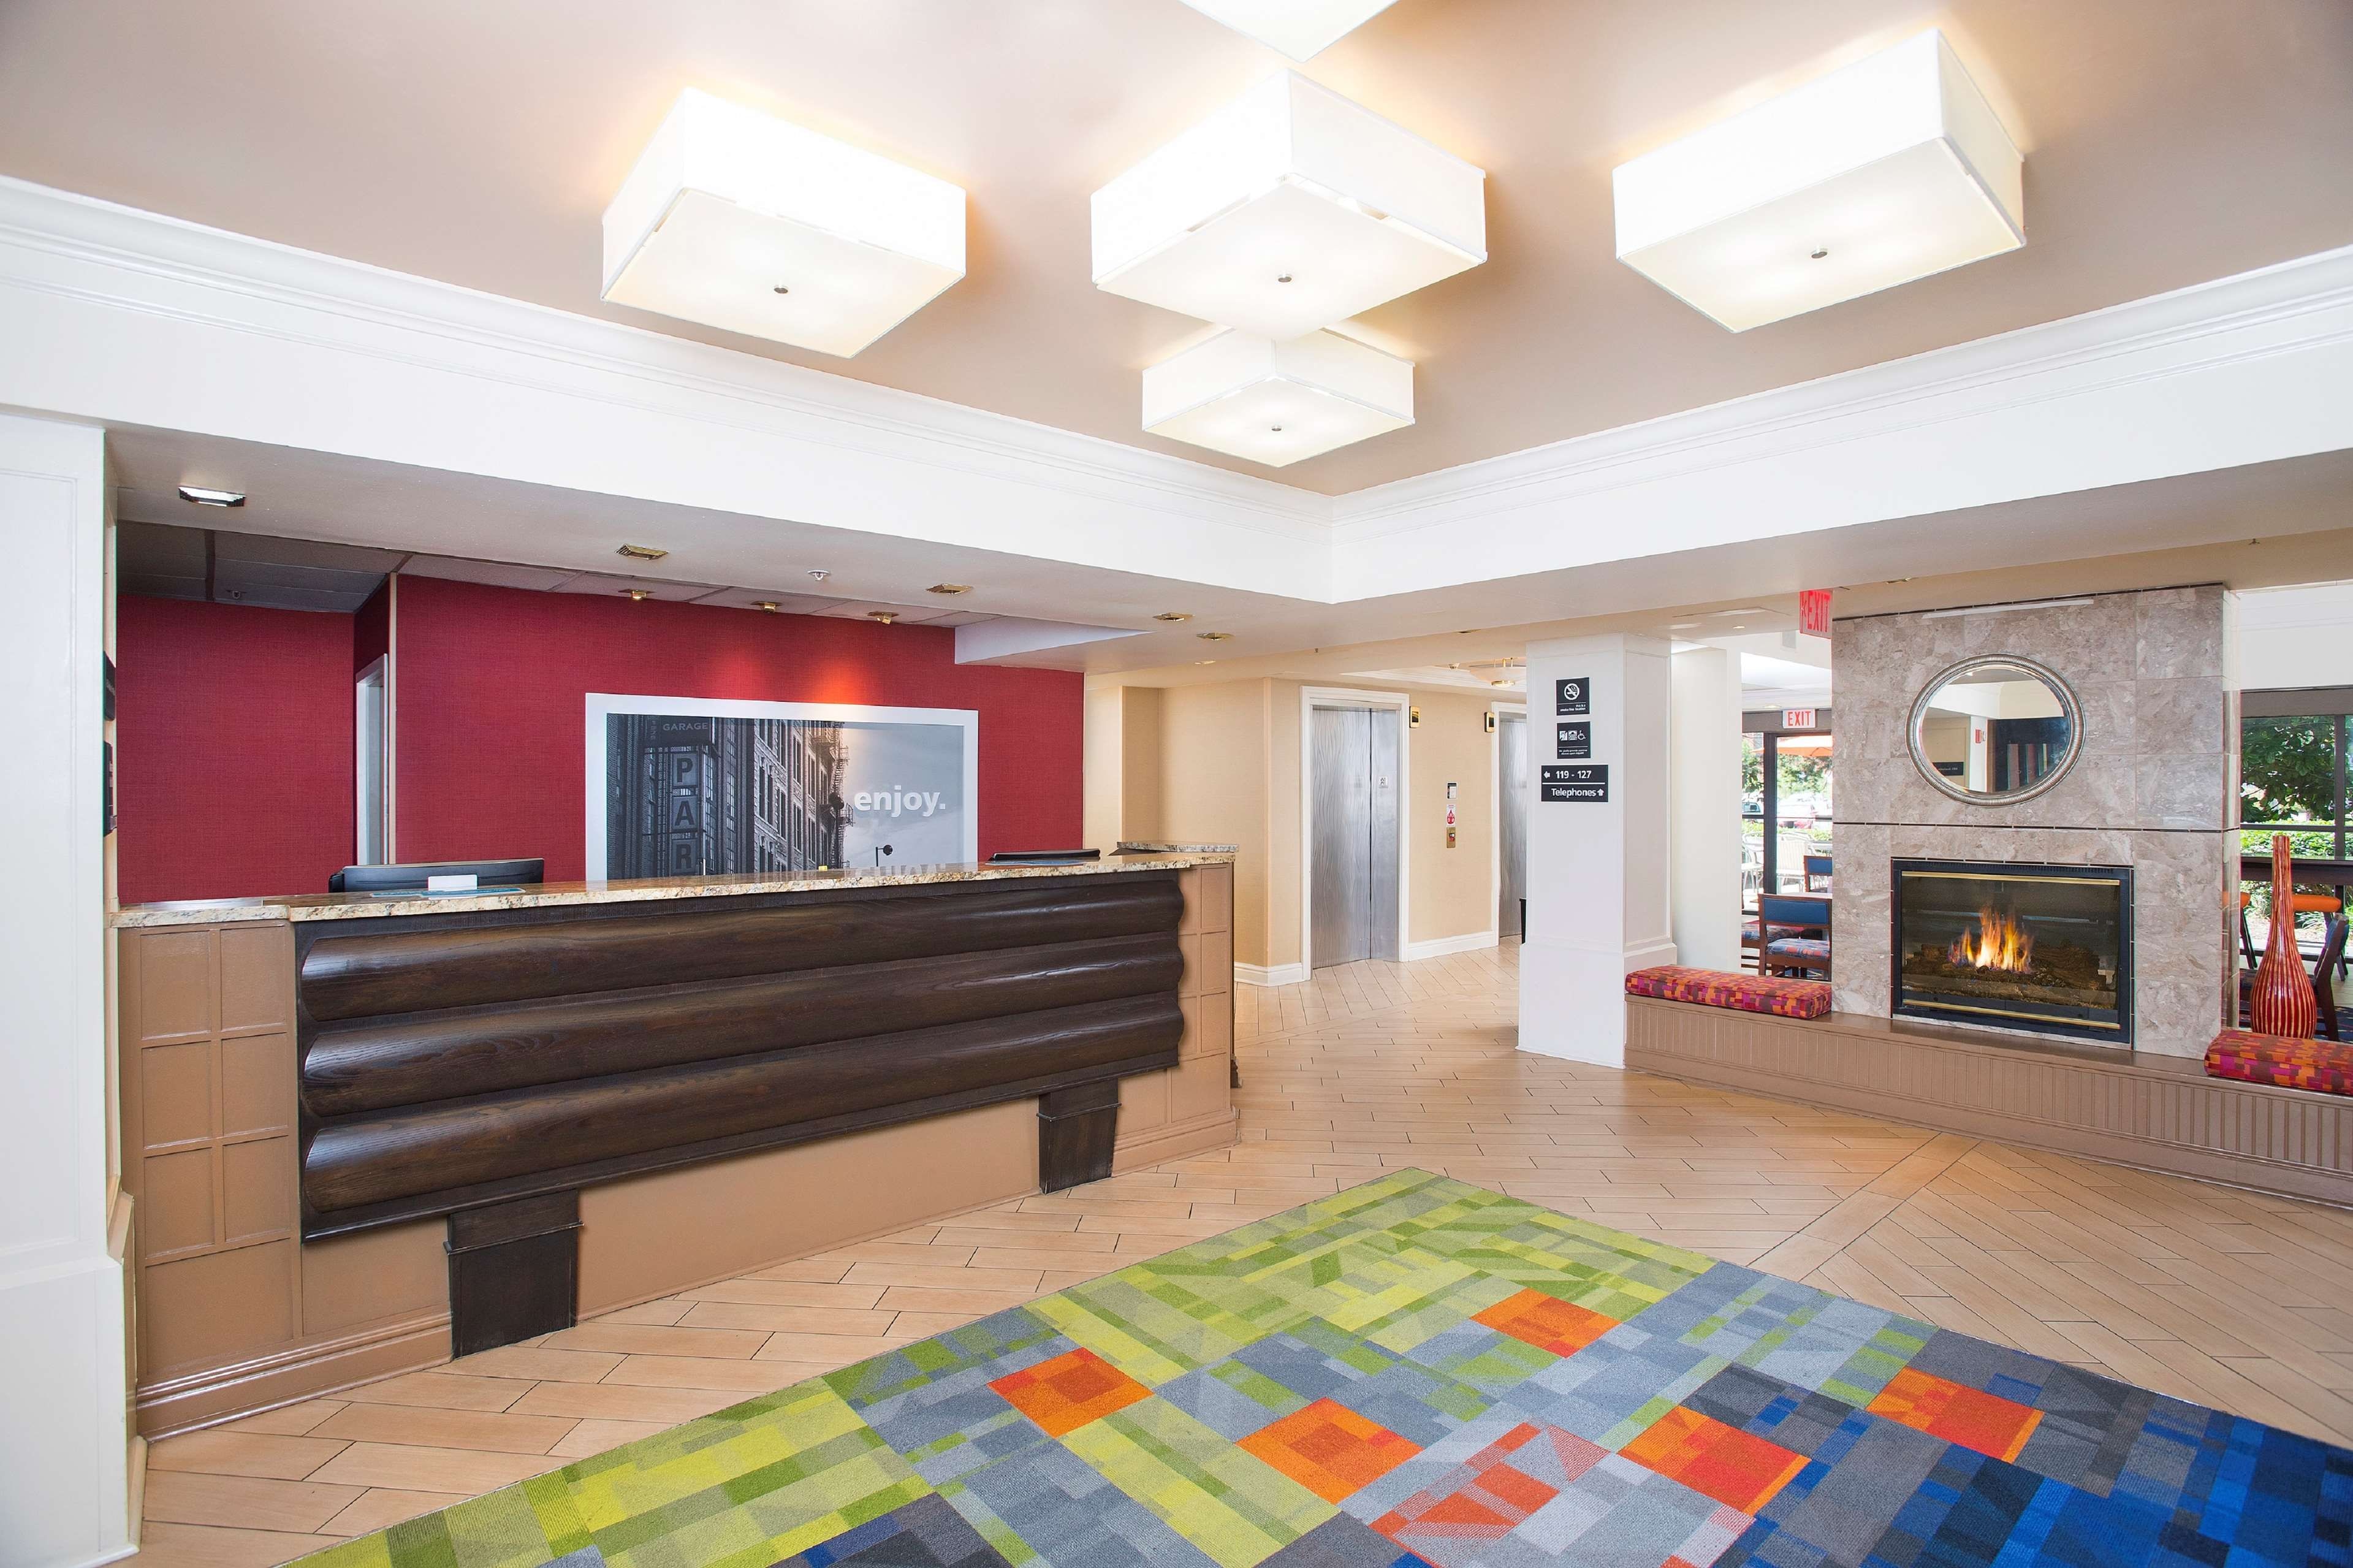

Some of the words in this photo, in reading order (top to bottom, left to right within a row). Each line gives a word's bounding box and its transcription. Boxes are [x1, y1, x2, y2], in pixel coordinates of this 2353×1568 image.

[1808, 591, 1831, 633] EXIT
[1788, 711, 1811, 726] EXIT
[854, 785, 946, 817] enjoy.
[1551, 788, 1596, 798] Telephones
